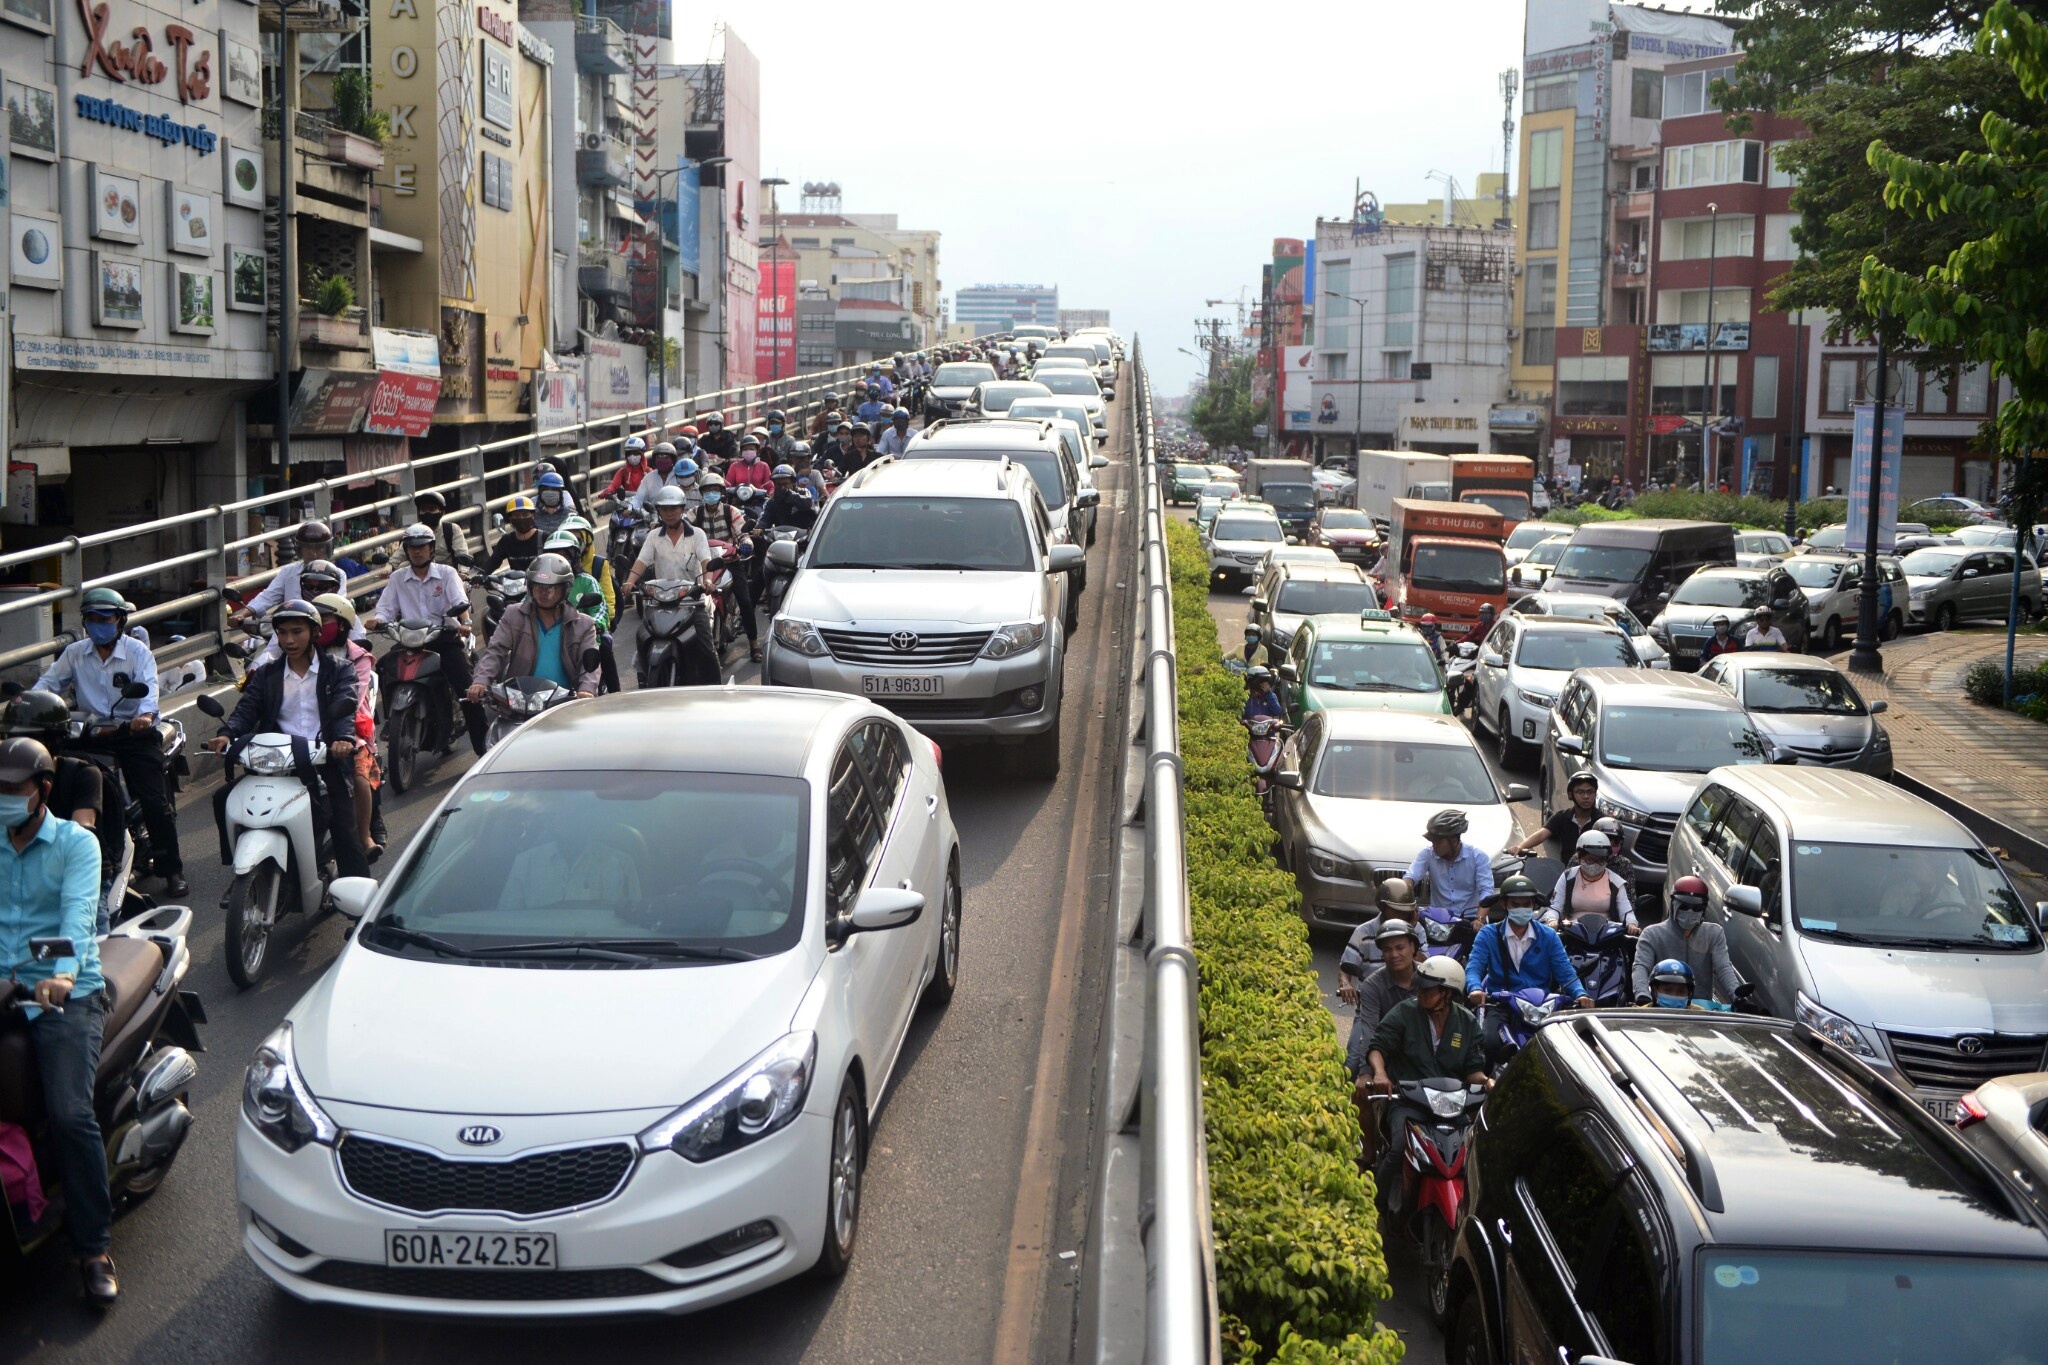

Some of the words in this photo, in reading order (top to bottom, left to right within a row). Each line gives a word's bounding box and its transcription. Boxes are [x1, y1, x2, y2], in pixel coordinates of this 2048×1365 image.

[1631, 36, 1664, 53] HOTEL
[144, 113, 183, 147] HIỆU
[183, 123, 217, 157] VIỆT
[1455, 417, 1479, 430] HOTEL
[1425, 517, 1438, 526] XE
[1441, 518, 1461, 528] THƯ
[1463, 518, 1484, 530] BÁO
[1439, 595, 1476, 604] KERRY
[865, 677, 938, 693] 51A-963.01
[463, 1128, 496, 1141] KIA
[391, 1234, 551, 1267] 60A-242.52
